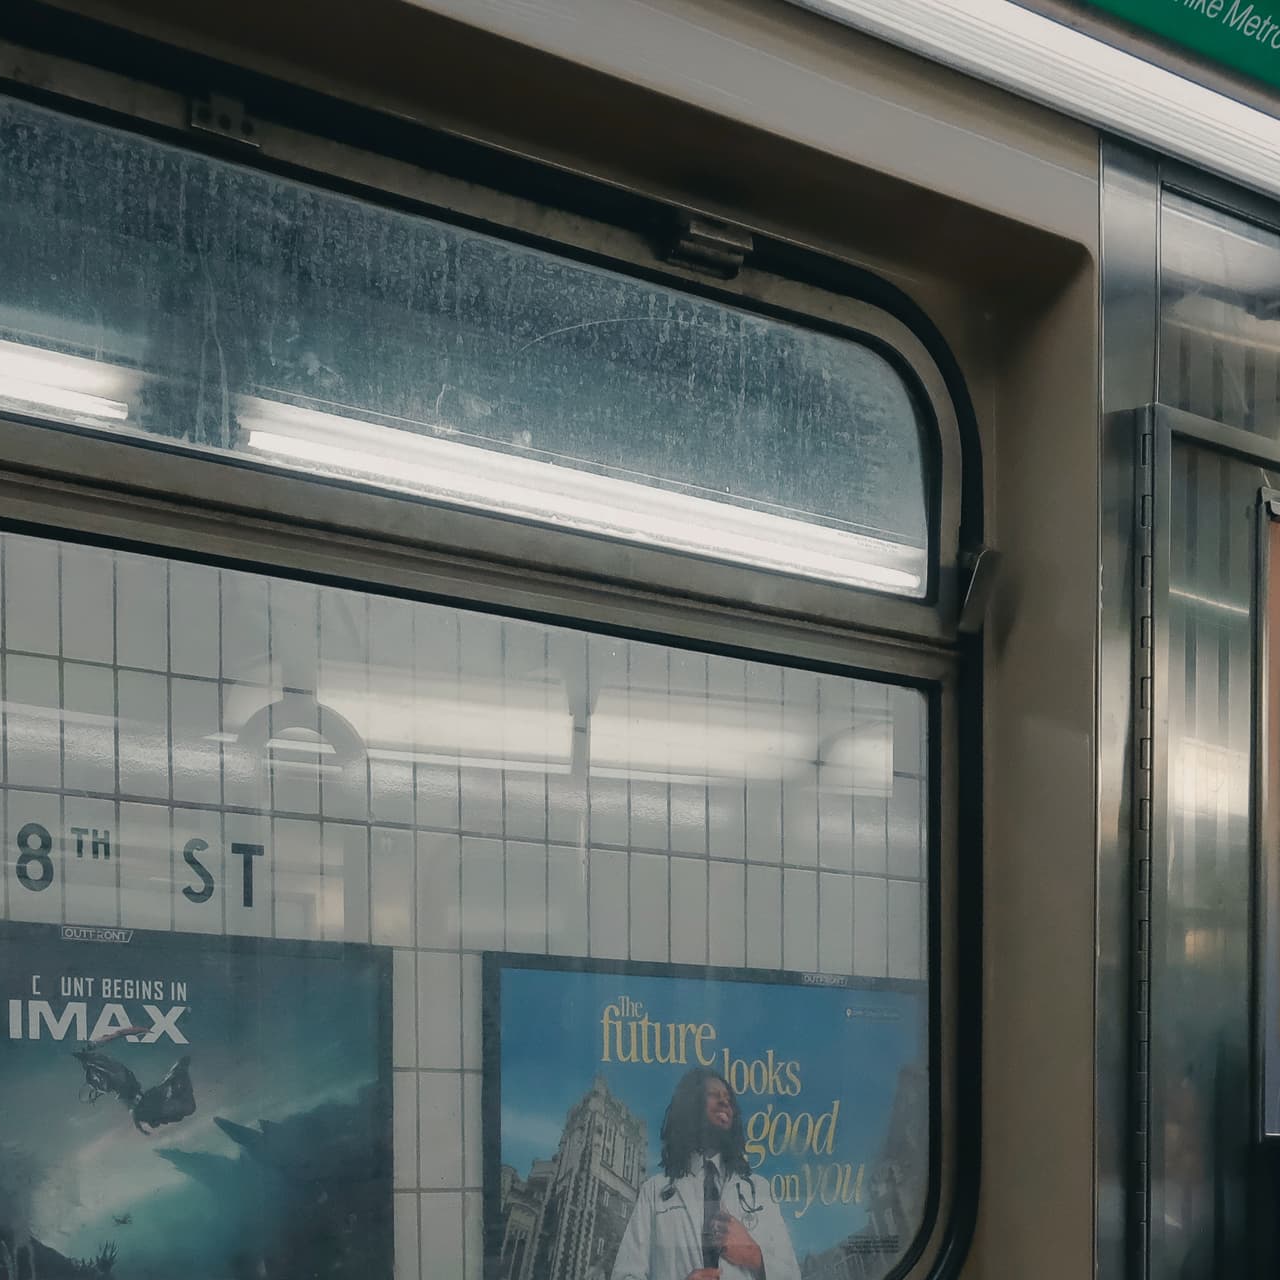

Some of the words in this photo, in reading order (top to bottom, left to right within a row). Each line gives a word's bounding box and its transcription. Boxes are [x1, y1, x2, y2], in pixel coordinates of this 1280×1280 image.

[182, 837, 265, 908] ST
[64, 927, 127, 942] OUTFRONT
[101, 978, 164, 1001] BEGINS
[171, 981, 187, 1002] IN
[618, 995, 643, 1018] The
[8, 999, 191, 1045] IMAX
[600, 1004, 717, 1066] future
[722, 1047, 802, 1097] looks
[744, 1099, 840, 1169] good
[771, 1174, 800, 1204] on
[794, 1163, 865, 1218] you
